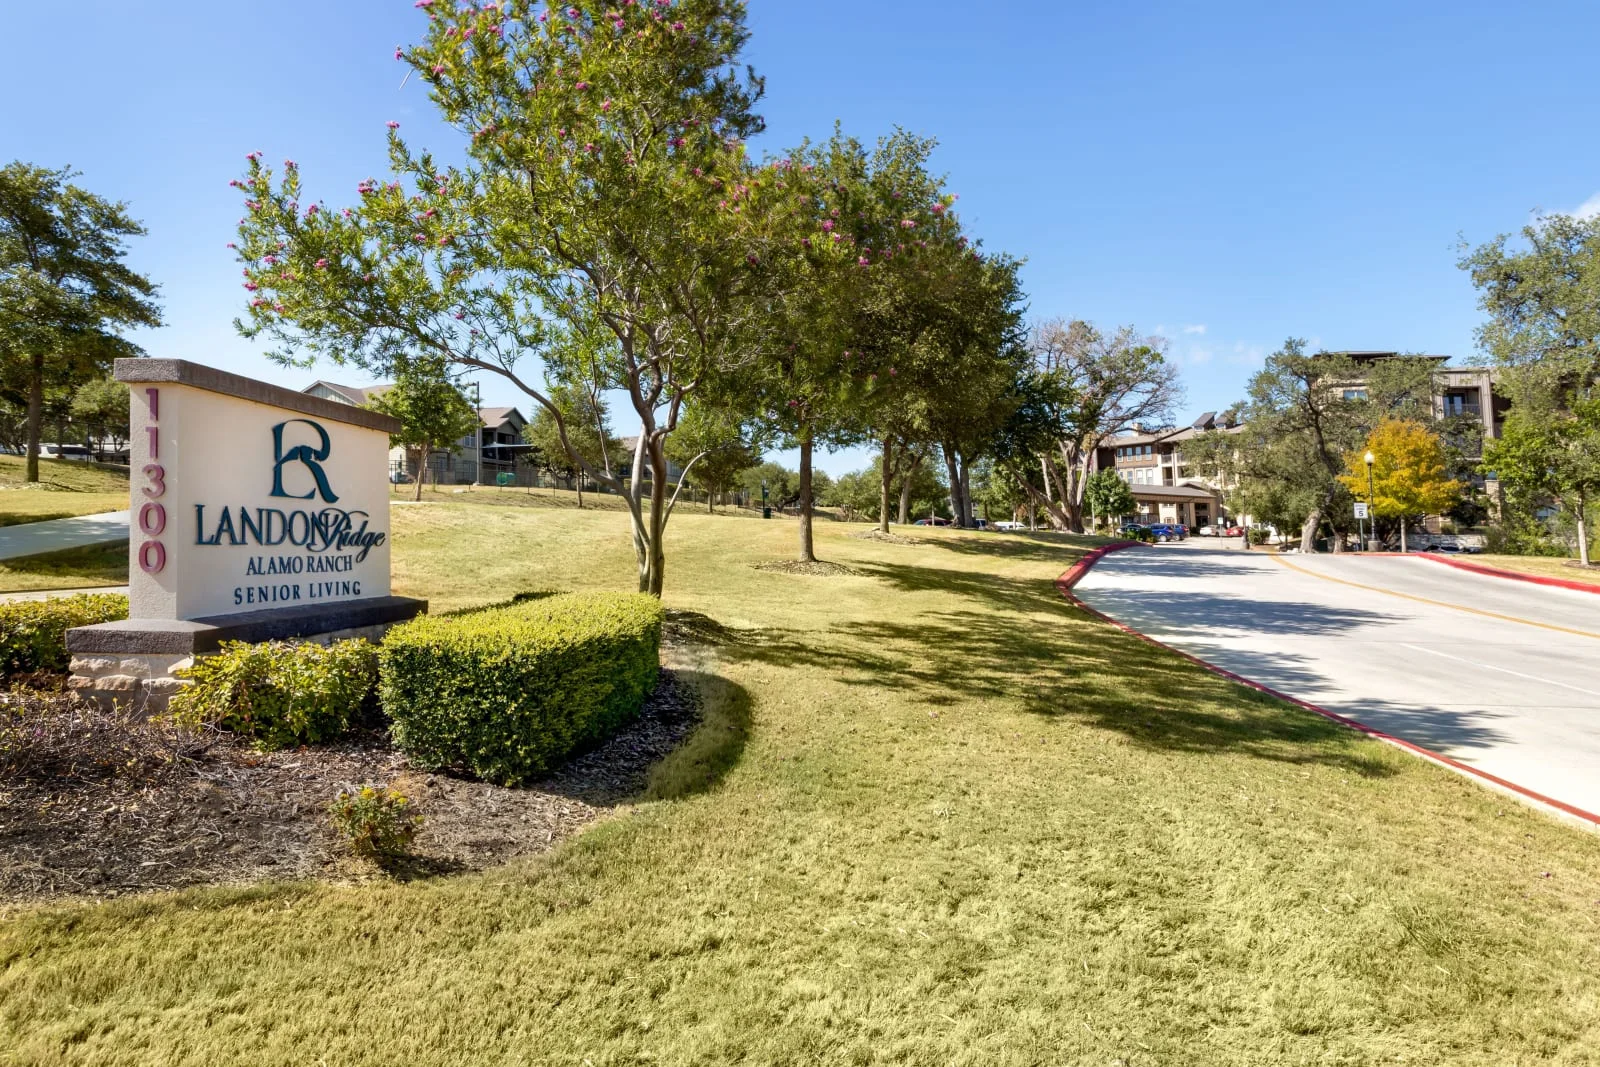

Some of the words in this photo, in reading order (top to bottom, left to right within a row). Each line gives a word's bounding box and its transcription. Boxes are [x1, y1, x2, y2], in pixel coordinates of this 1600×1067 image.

[139, 388, 166, 573] 11300
[194, 504, 329, 546] LANDON
[306, 507, 386, 564] Ridge
[246, 556, 303, 576] ALAMO
[306, 554, 353, 573] RANCH
[234, 584, 302, 606] SENIOR
[309, 581, 361, 598] LIVING
